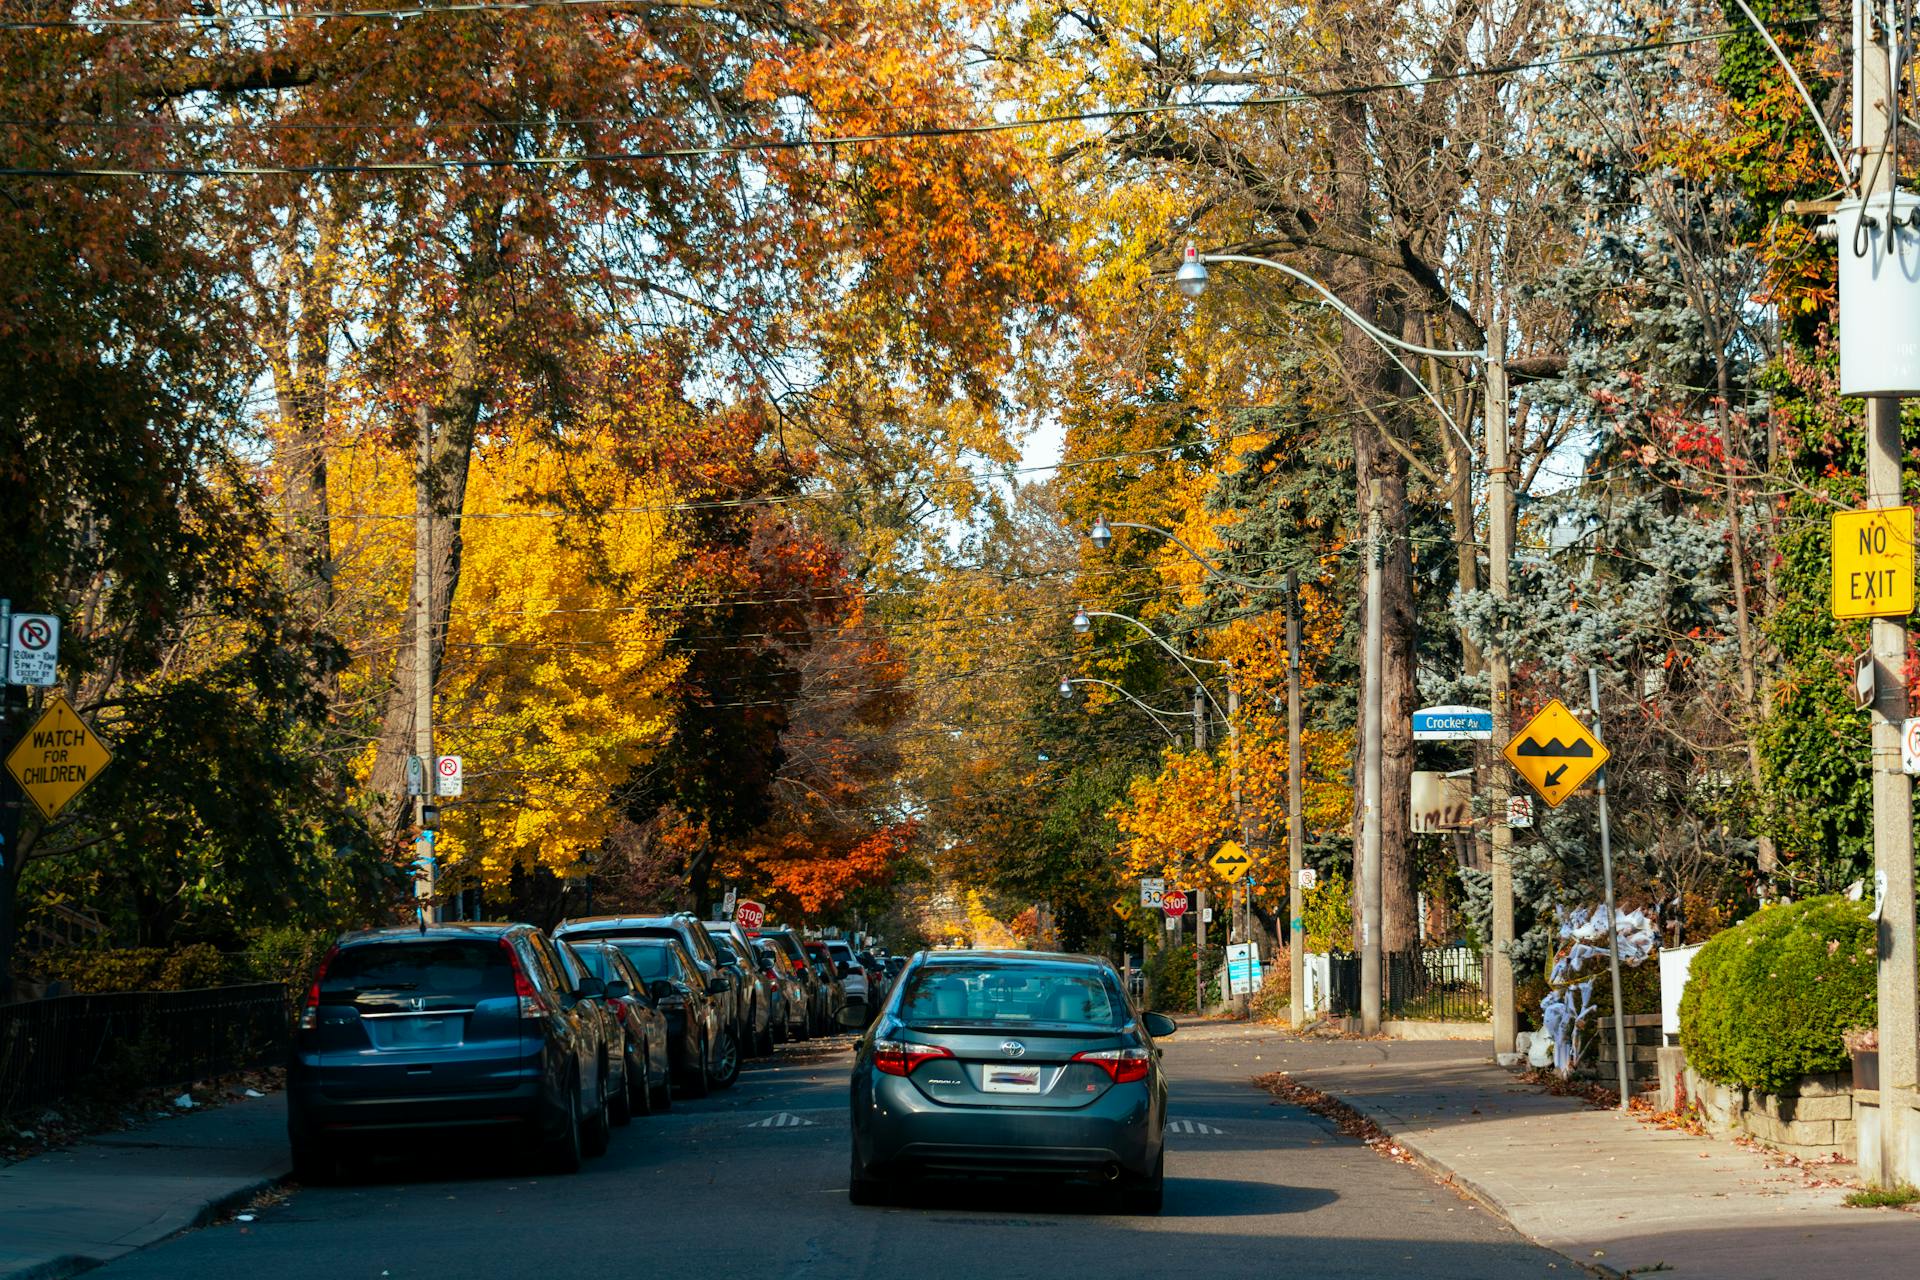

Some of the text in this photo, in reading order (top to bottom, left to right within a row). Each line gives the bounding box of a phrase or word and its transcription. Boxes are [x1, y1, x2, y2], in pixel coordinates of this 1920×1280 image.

[1859, 526, 1886, 556] NO
[1851, 569, 1896, 600] EXIT
[1426, 716, 1466, 729] Crocker
[33, 729, 86, 749] WATCH
[43, 749, 69, 764] FOR
[23, 765, 87, 785] CHILDREN
[1144, 890, 1161, 904] 30
[1163, 898, 1187, 910] STOP
[738, 907, 762, 923] STOP
